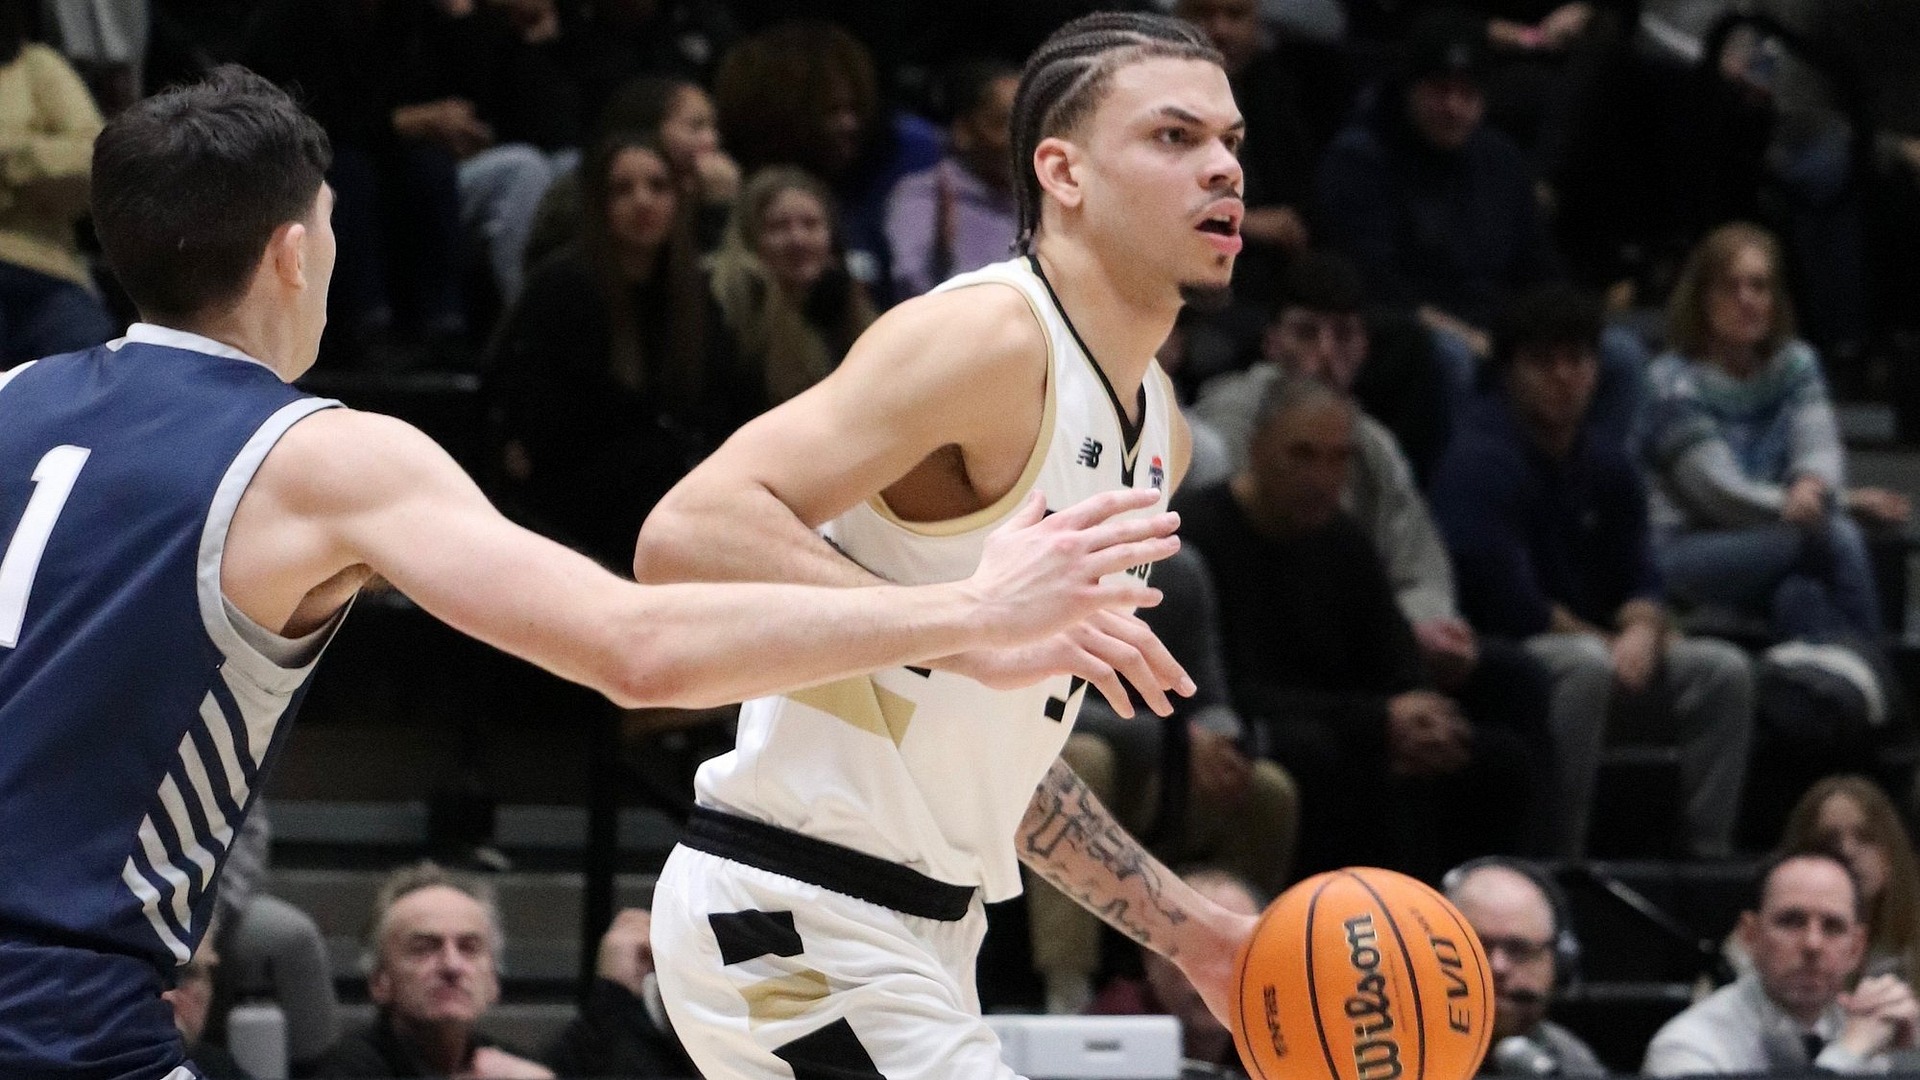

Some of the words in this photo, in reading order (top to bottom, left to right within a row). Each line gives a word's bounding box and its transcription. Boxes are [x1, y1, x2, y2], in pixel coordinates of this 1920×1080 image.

[0, 445, 91, 649] 1
[1343, 912, 1404, 1080] Wilson
[1428, 936, 1471, 1035] EVO
